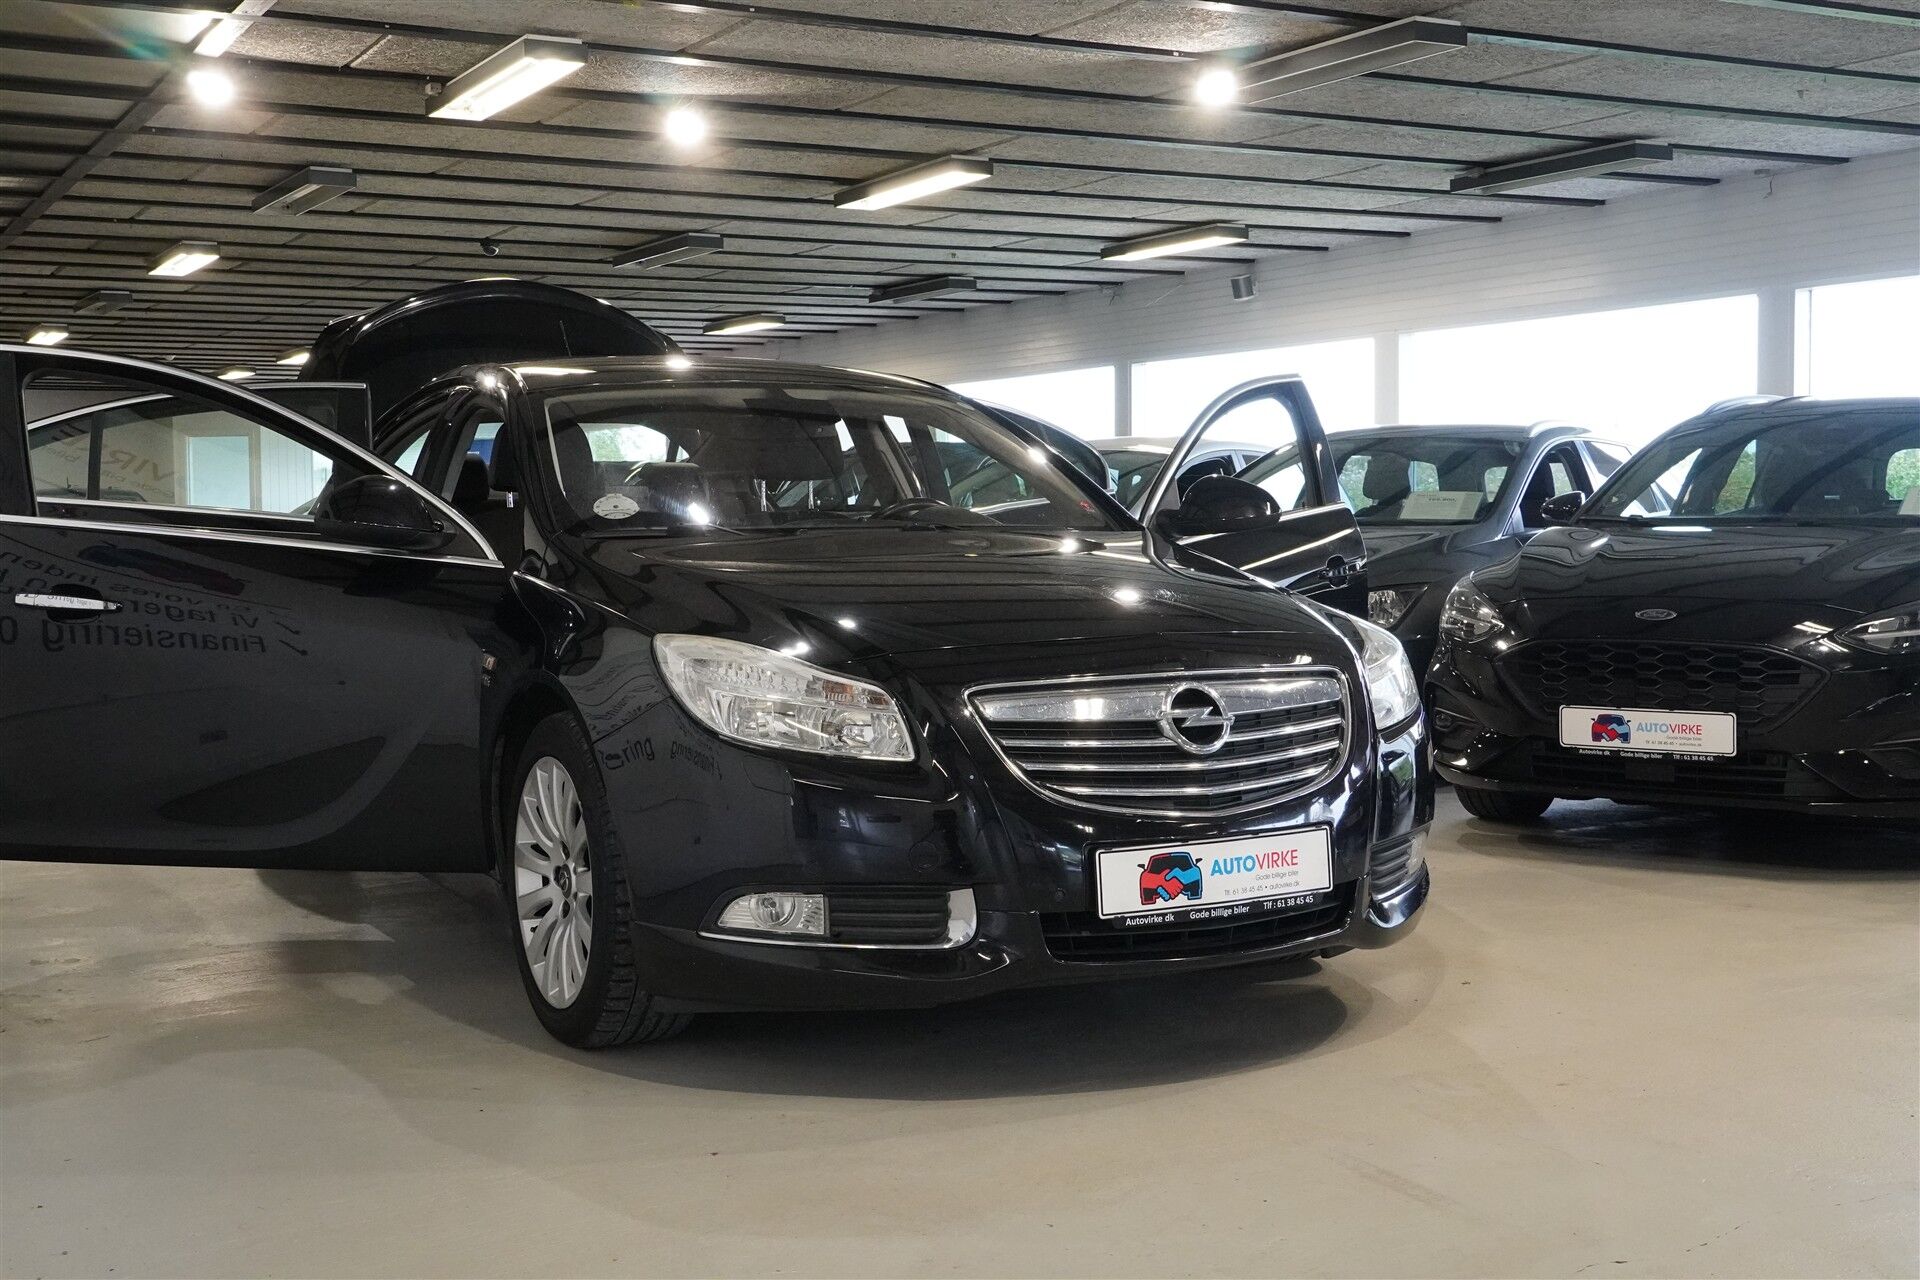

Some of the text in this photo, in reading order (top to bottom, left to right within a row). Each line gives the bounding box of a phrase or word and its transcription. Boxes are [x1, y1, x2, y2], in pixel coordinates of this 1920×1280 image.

[1636, 721, 1702, 735] AUTOVIRKE
[1210, 849, 1299, 876] AUTOVIRKE
[1255, 872, 1271, 881] Gode
[1288, 869, 1299, 878] biler
[1232, 887, 1239, 895] 61
[1240, 886, 1248, 894] 38
[1248, 885, 1256, 893] 45
[1256, 884, 1264, 892] 45
[1125, 915, 1163, 927] Autovirke
[1165, 914, 1175, 922] dk
[1190, 910, 1210, 919] Gode
[1211, 907, 1233, 919] billige
[1233, 905, 1250, 915] biler
[1277, 899, 1286, 907] 61
[1286, 897, 1295, 906] 38
[1296, 896, 1304, 905] 45
[1305, 895, 1314, 903] 45
